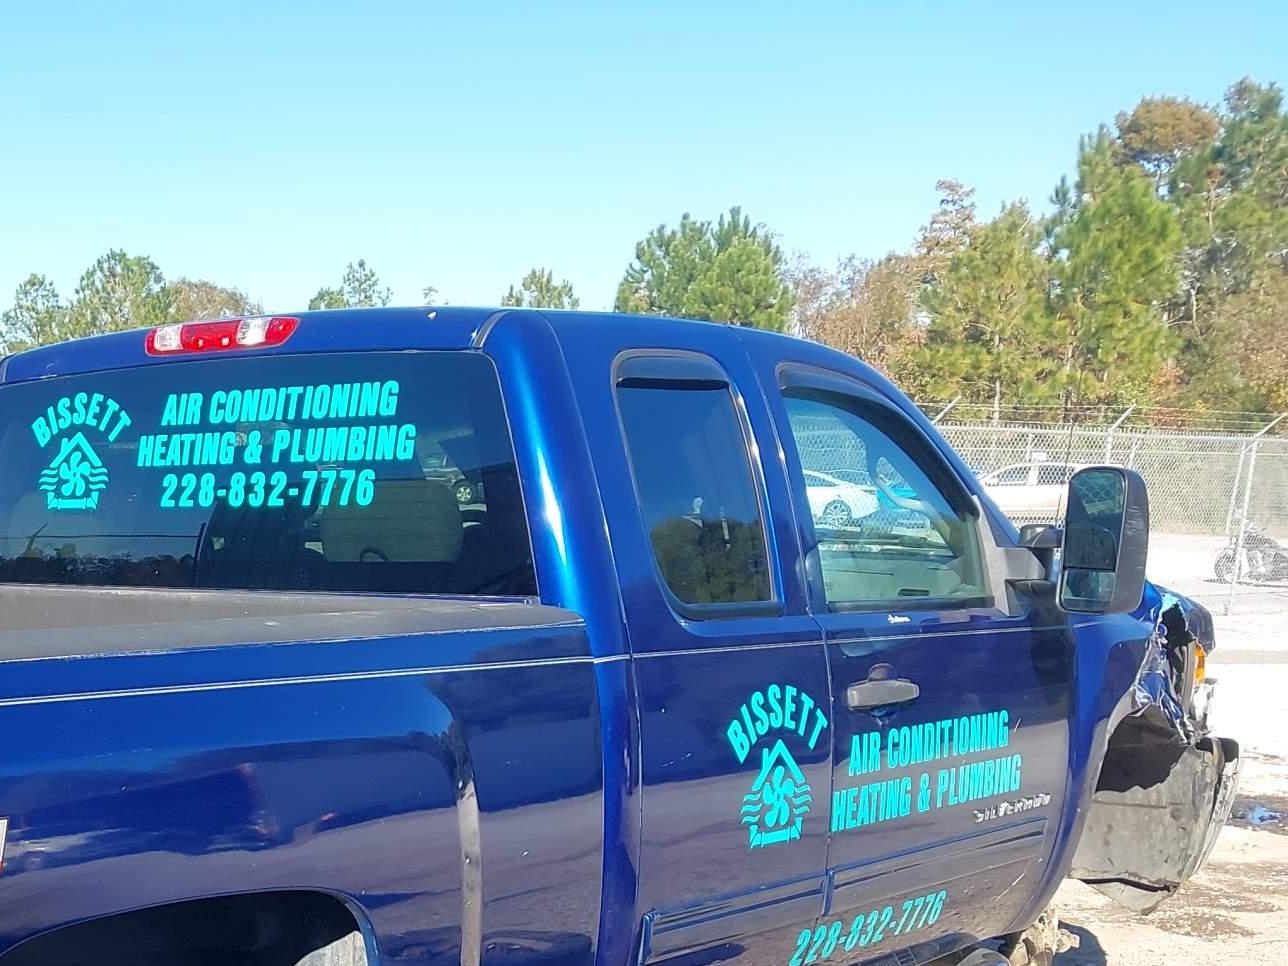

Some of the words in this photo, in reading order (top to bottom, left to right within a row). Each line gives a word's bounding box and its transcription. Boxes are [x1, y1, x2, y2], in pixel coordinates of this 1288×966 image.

[31, 392, 132, 448] BISSETT
[160, 392, 204, 427] AIR
[208, 380, 400, 424] CONDITIONING
[137, 431, 240, 467] HEATING
[243, 430, 263, 465] &
[271, 423, 417, 463] PLUMBING
[160, 468, 376, 508] 228-832-7776
[727, 683, 828, 764] BISSETT
[848, 731, 882, 777] AIR
[887, 710, 1010, 770] CONDITIONING
[831, 776, 912, 832] HEATING
[917, 773, 931, 813] &
[936, 754, 1022, 809] PLUMBING
